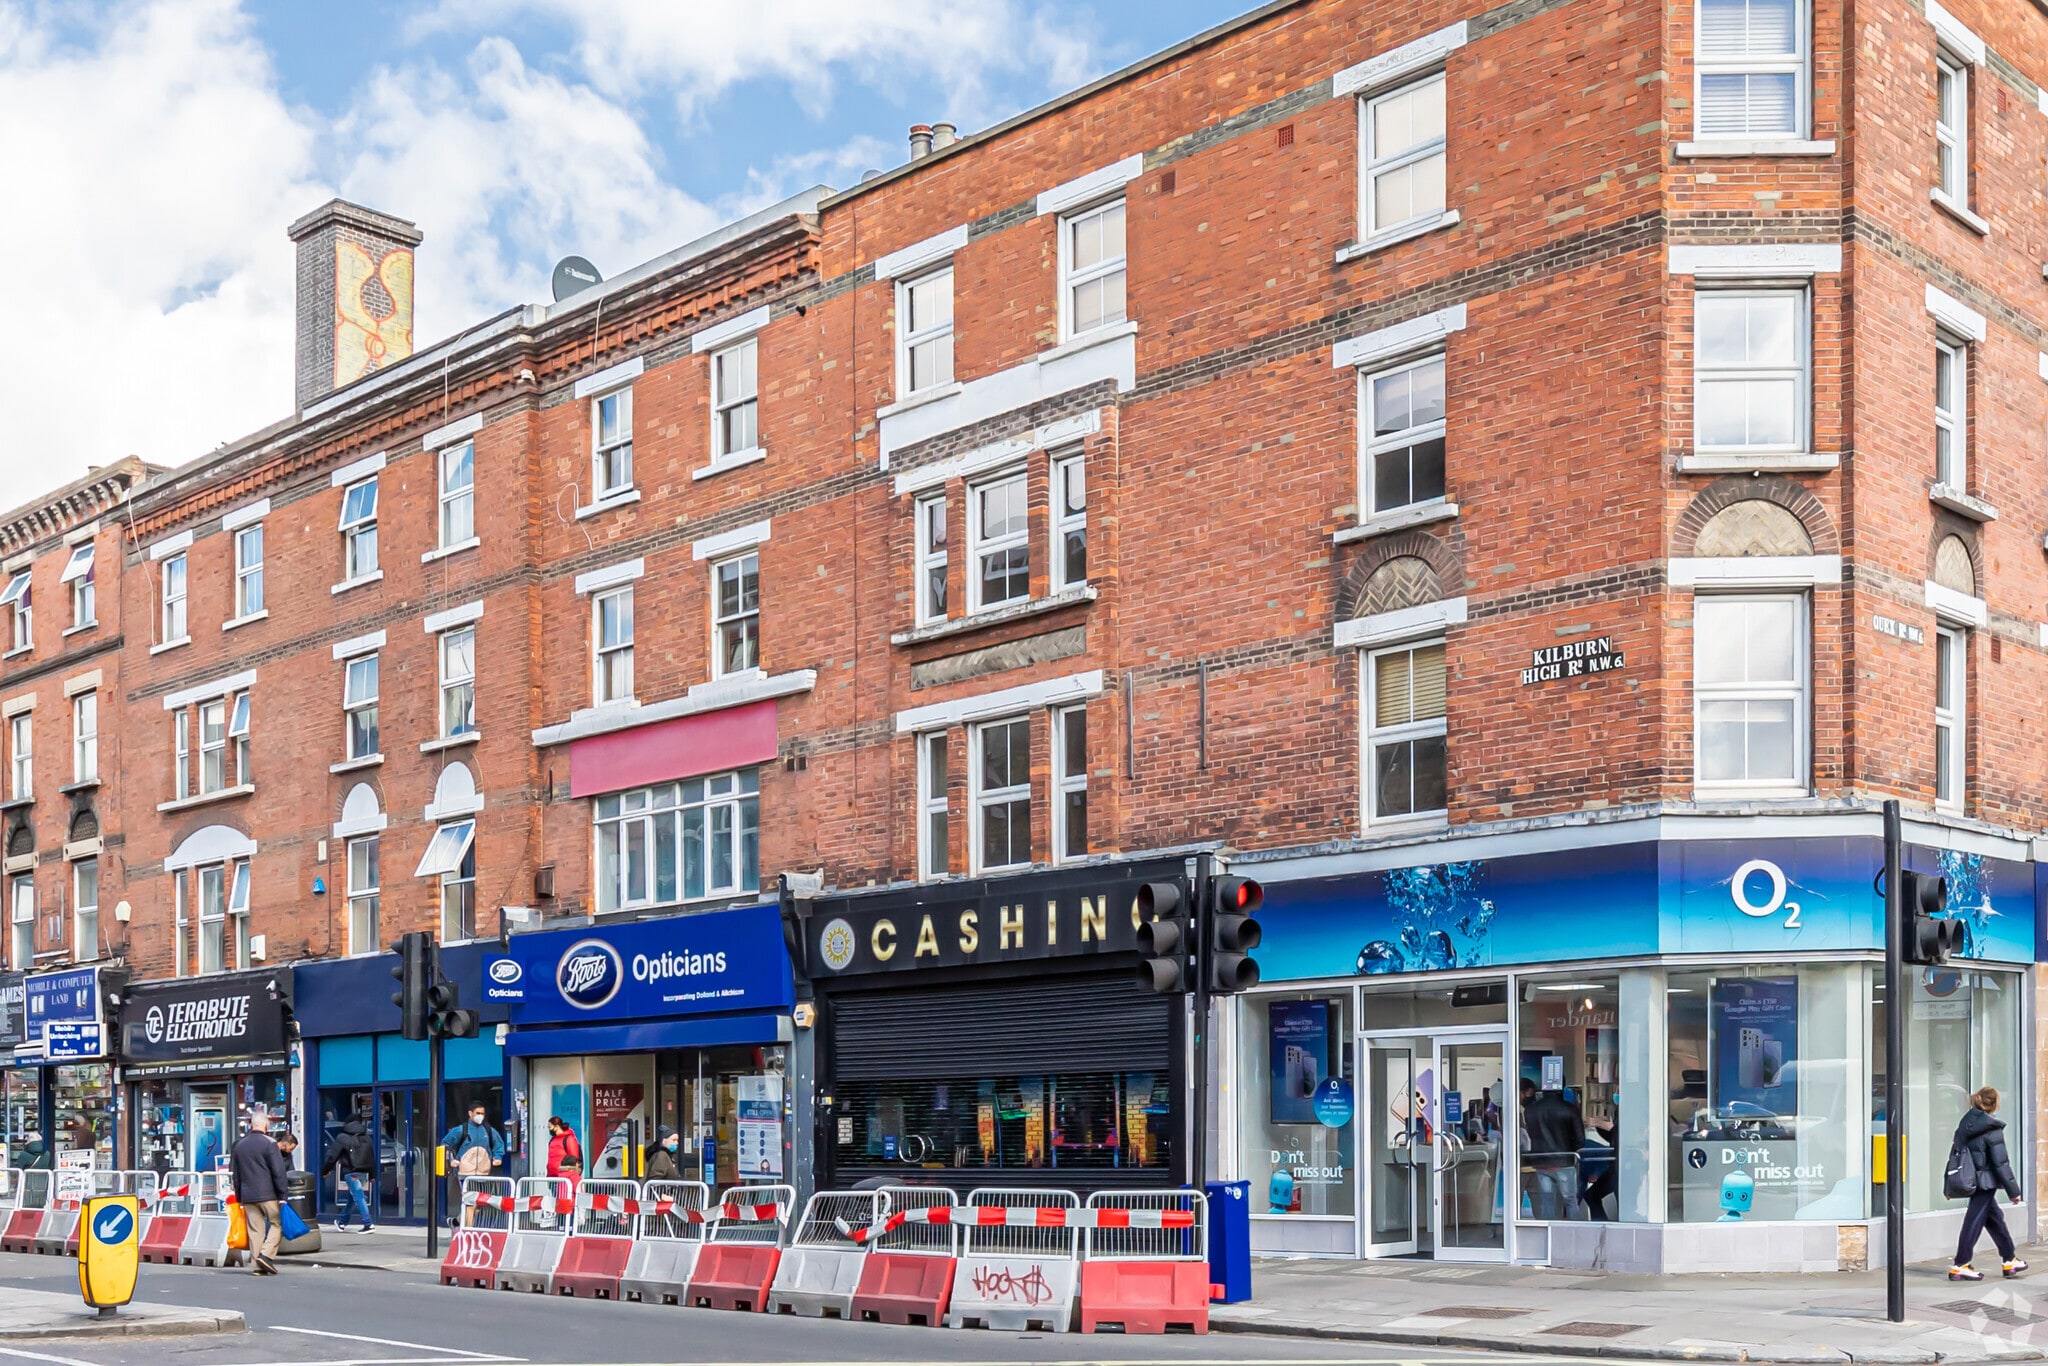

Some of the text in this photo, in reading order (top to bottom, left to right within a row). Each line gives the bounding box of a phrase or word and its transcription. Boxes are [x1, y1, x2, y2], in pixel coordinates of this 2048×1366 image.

[1533, 637, 1610, 666] KILBURN
[1522, 663, 1561, 685] HIGH
[564, 954, 607, 992] Boots
[632, 948, 727, 985] Opticians
[27, 974, 94, 993] MOBILE & COMPUTER
[51, 993, 69, 1005] LAND
[488, 988, 524, 998] Opticians
[167, 995, 251, 1024] TERABYTE
[1724, 1005, 1747, 1013] Google
[166, 1016, 248, 1042] ELECTRONICS
[595, 1089, 623, 1098] HALF
[596, 1098, 627, 1107] PRICE
[1271, 1150, 1305, 1164] Don't
[1721, 1148, 1770, 1165] Don't
[1293, 1163, 1344, 1178] miss out
[1754, 1162, 1825, 1179] miss out
